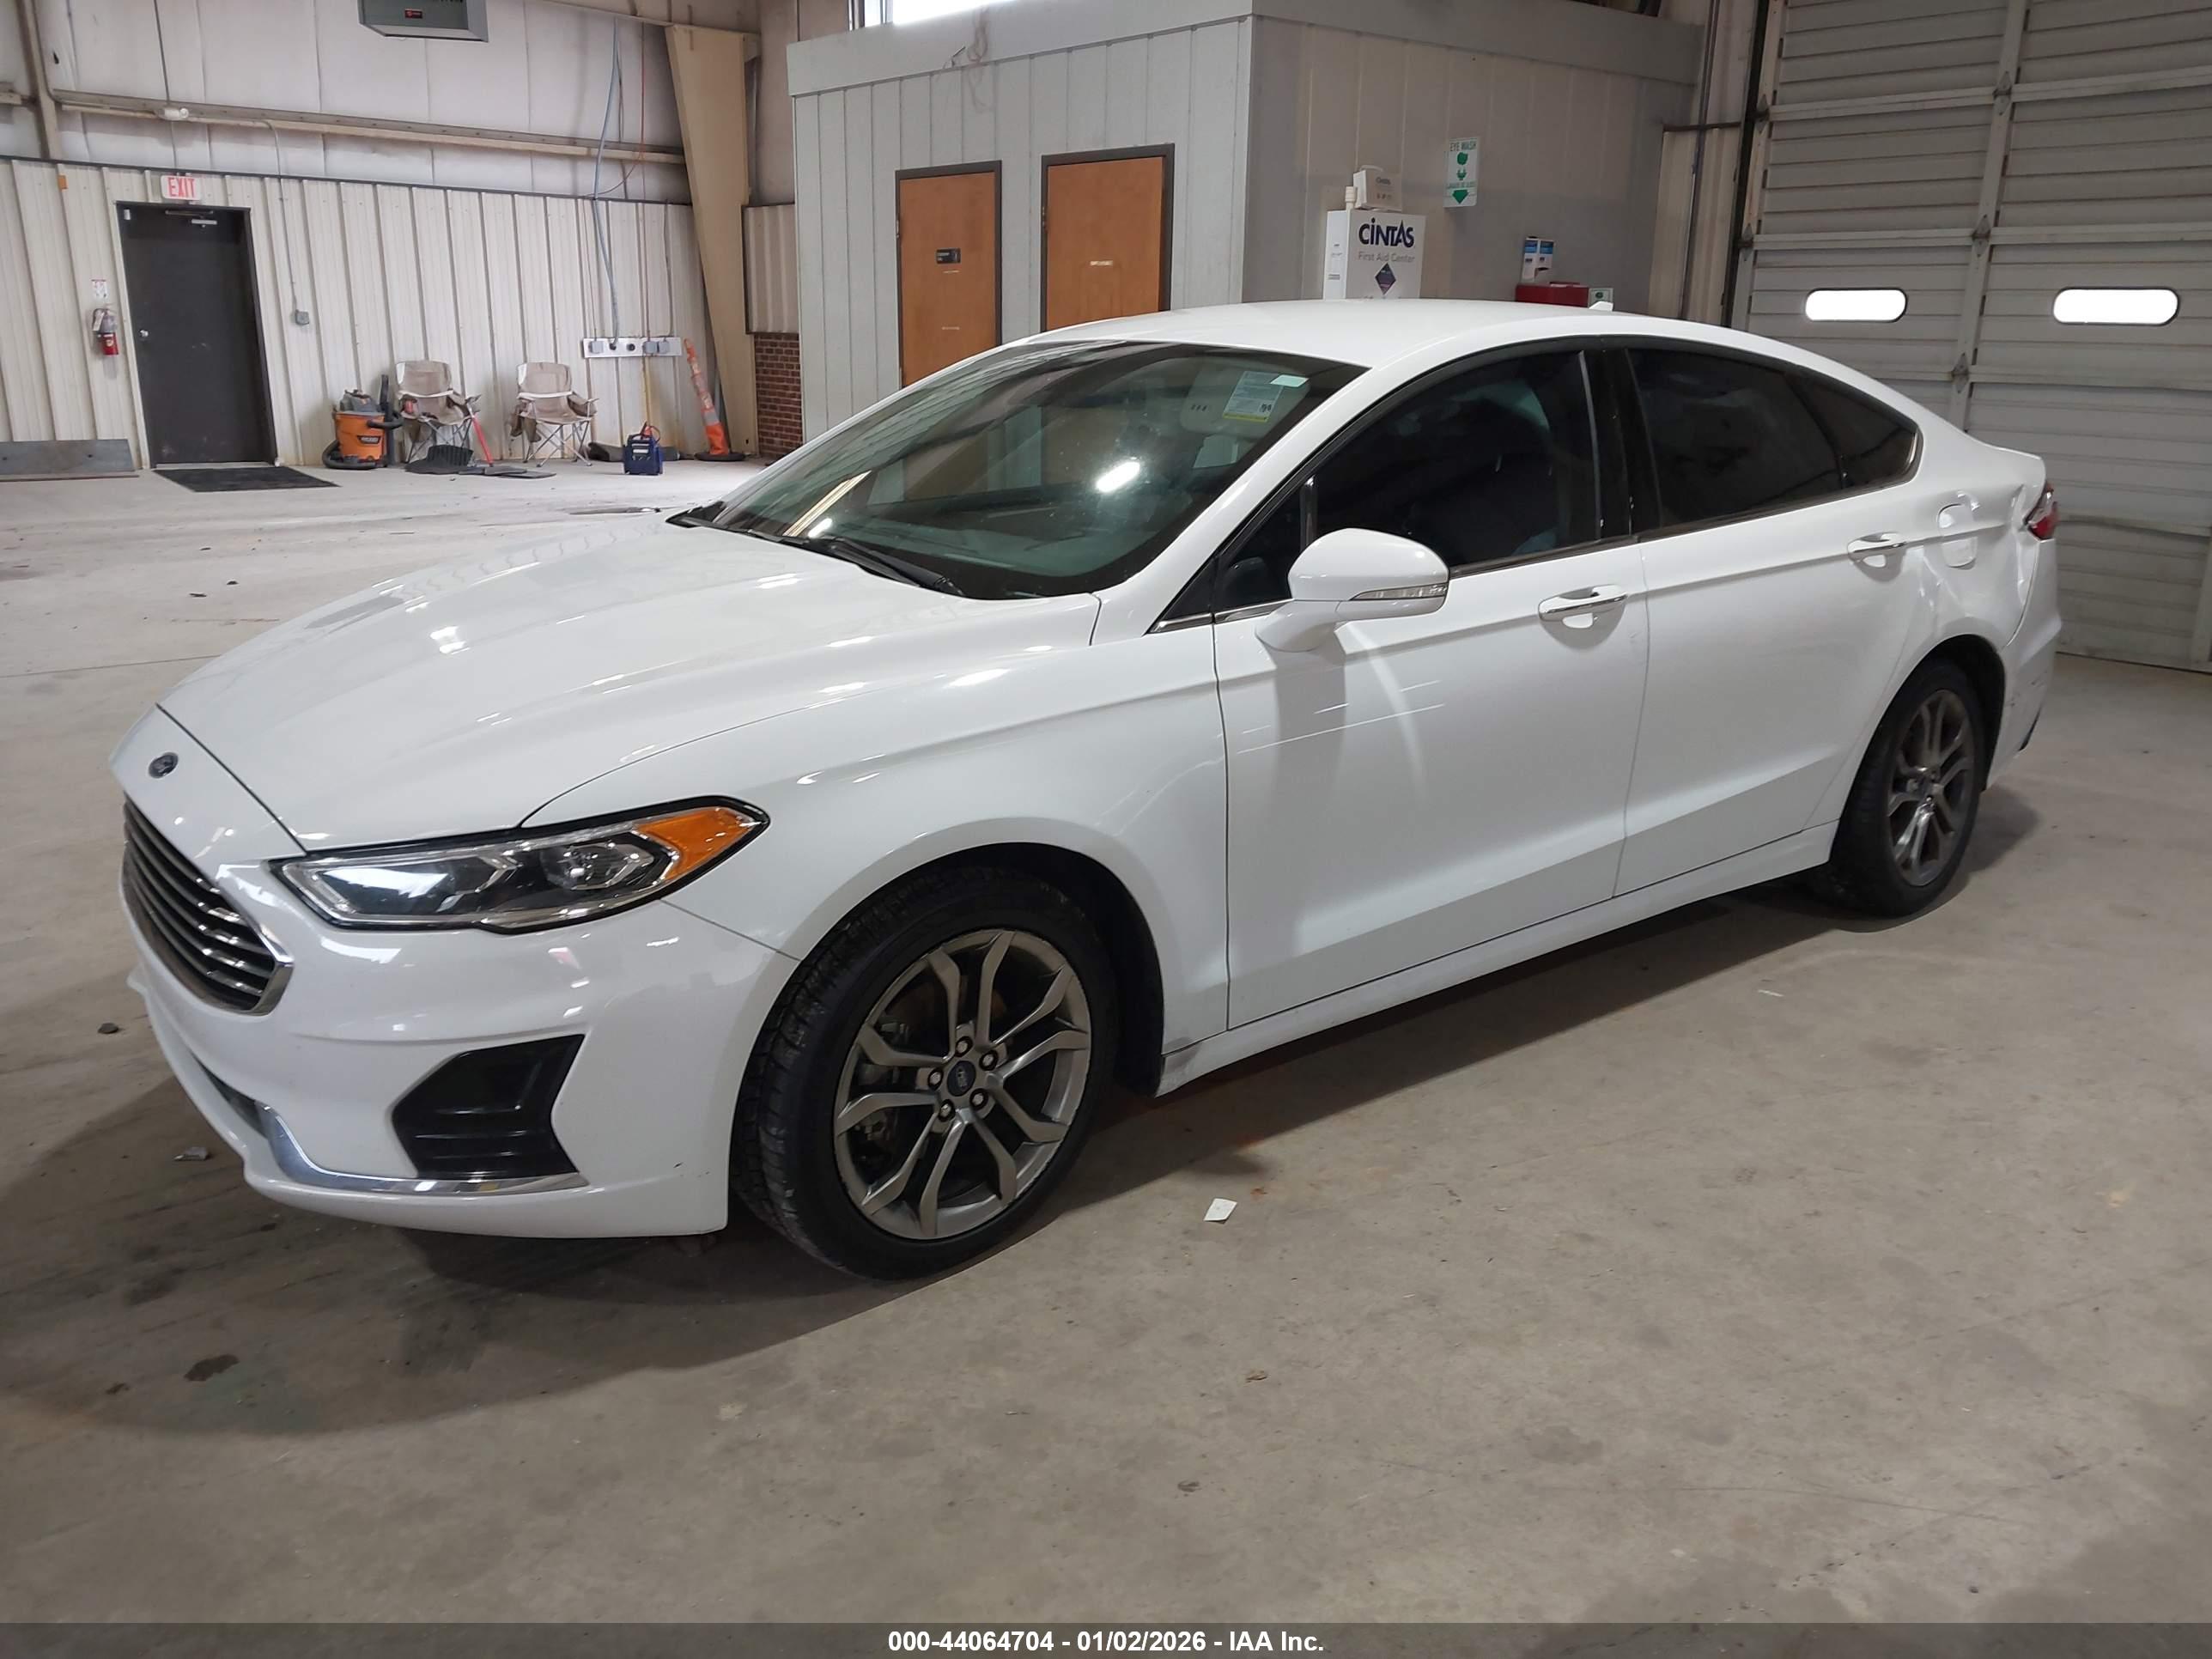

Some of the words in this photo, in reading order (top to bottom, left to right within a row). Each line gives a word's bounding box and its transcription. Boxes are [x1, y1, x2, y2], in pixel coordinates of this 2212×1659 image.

[167, 177, 195, 198] EXIT
[1358, 251, 1375, 261] First
[1376, 252, 1389, 261] Aid
[1391, 252, 1416, 263] Center
